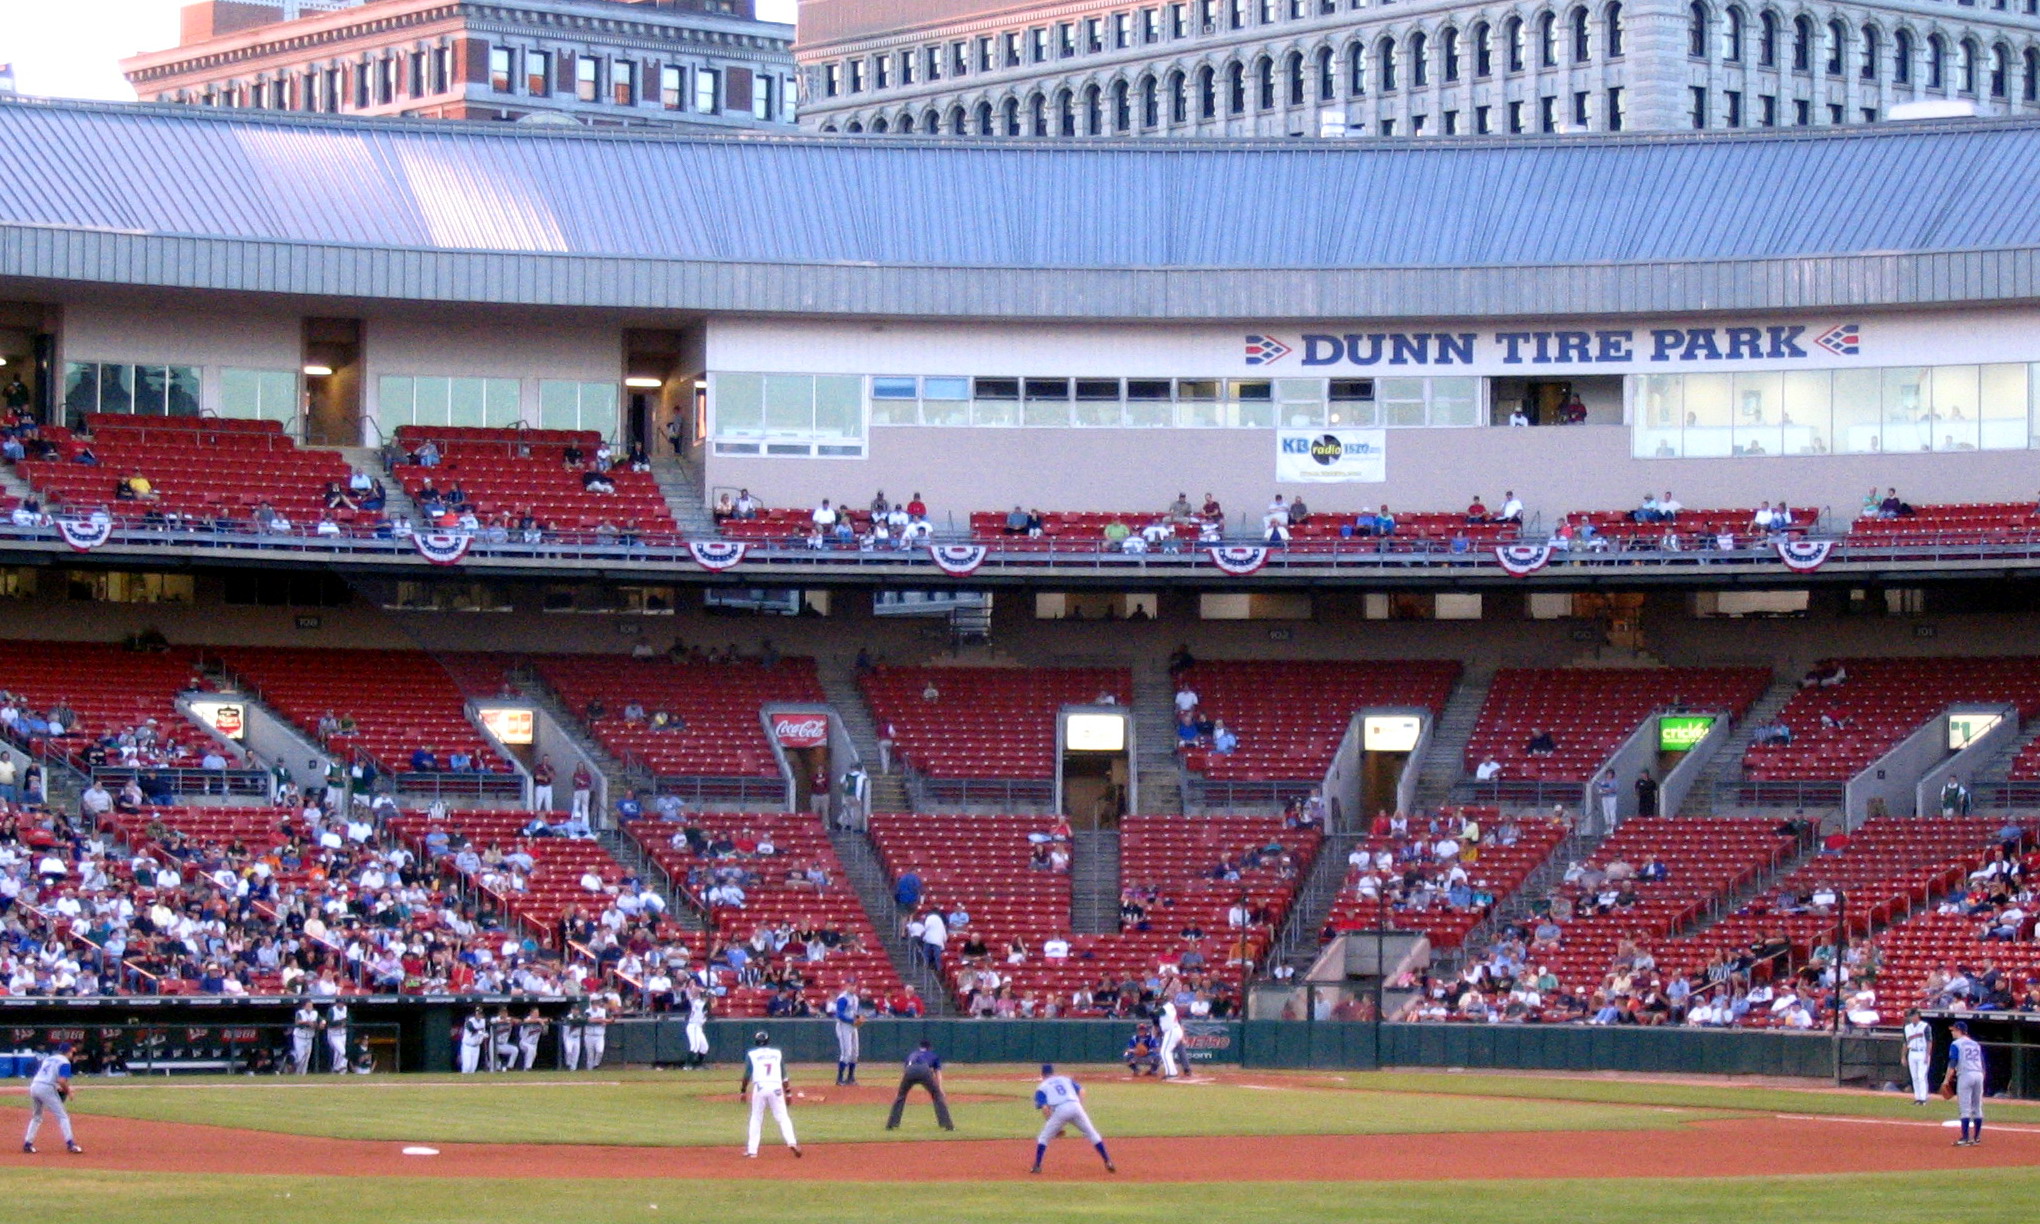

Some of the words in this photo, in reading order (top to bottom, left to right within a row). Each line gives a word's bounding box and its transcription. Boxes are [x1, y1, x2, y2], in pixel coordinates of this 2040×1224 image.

[1301, 333, 1478, 366] DUNN
[1495, 331, 1633, 364] TIRE
[1650, 325, 1808, 361] PARK
[1282, 438, 1309, 453] KB
[1312, 444, 1341, 454] radio
[1343, 443, 1369, 454] 1520
[775, 719, 826, 738] Coca-Cola
[1964, 1047, 1980, 1061] 22
[763, 1063, 772, 1076] 7
[1055, 1084, 1067, 1096] 8
